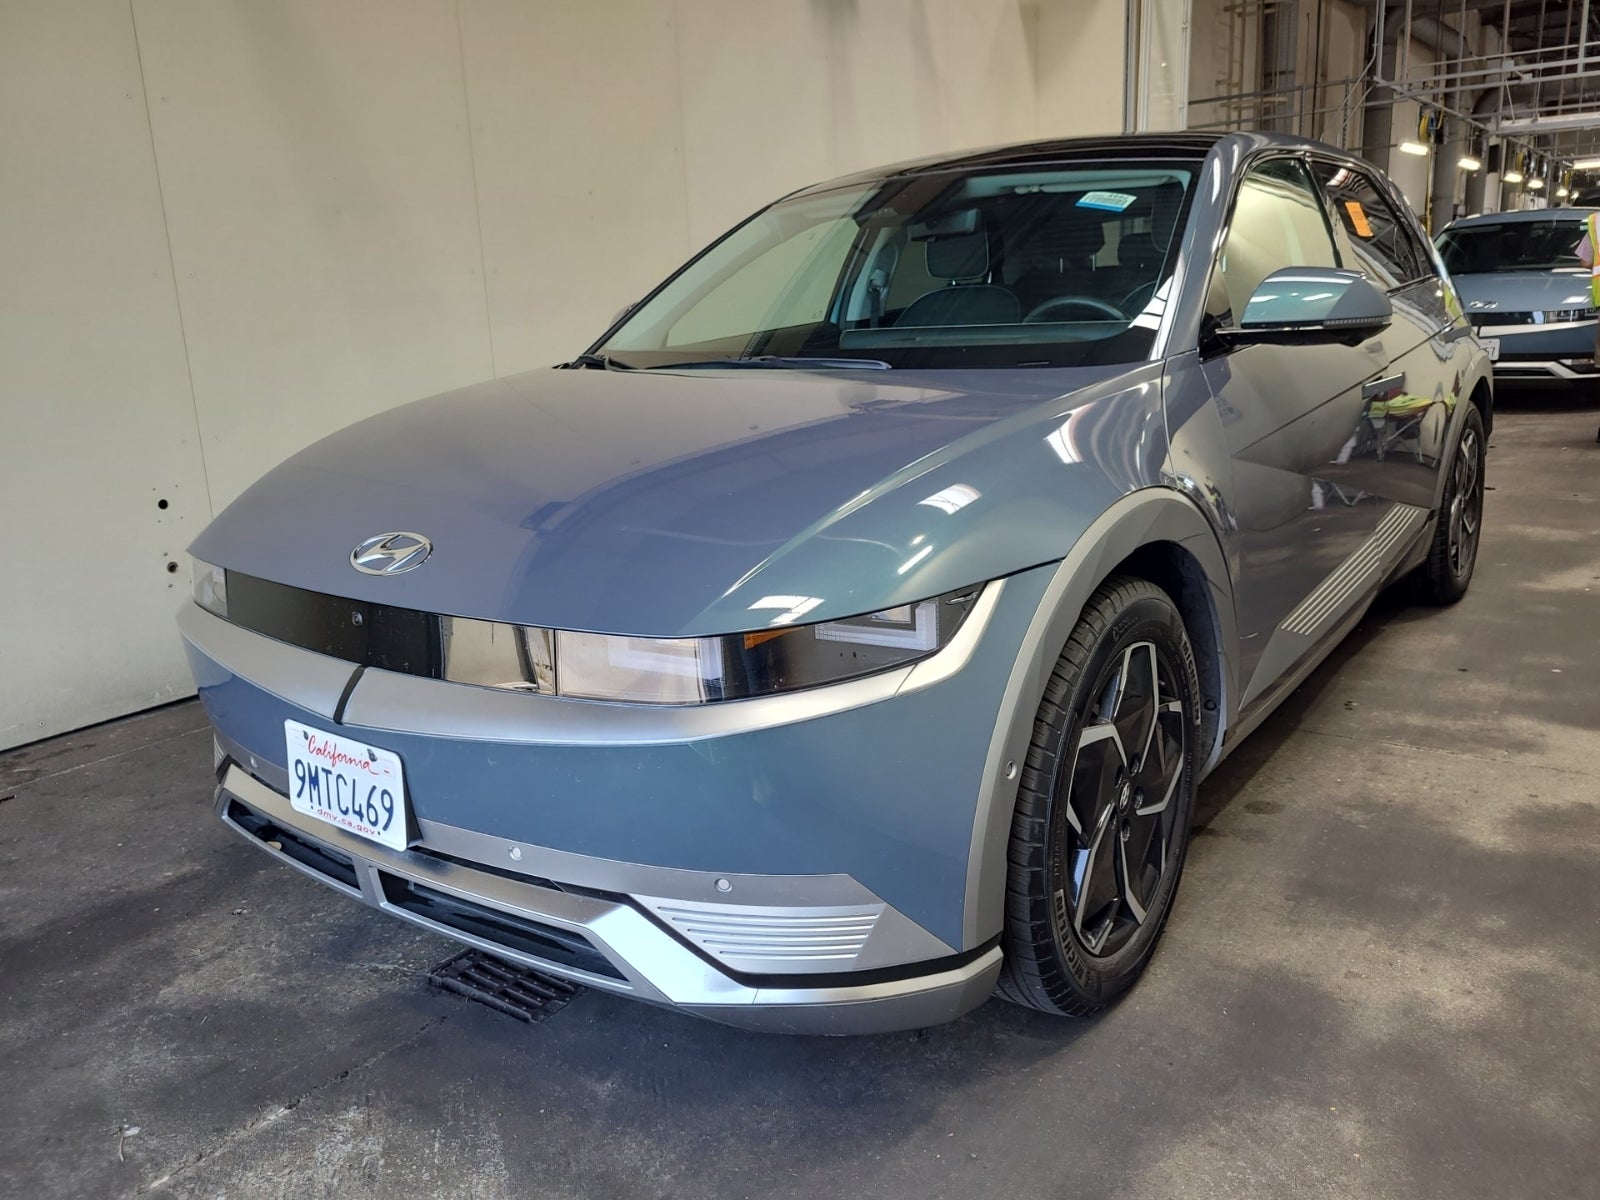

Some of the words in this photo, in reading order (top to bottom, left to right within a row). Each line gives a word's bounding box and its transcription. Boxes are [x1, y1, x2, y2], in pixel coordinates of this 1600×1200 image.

[1180, 640, 1200, 721] MICHELIN
[308, 734, 378, 775] California
[294, 758, 394, 832] 9MTC469
[317, 809, 375, 835] dmv.ca.gov
[1055, 895, 1084, 980] MICHELIN
